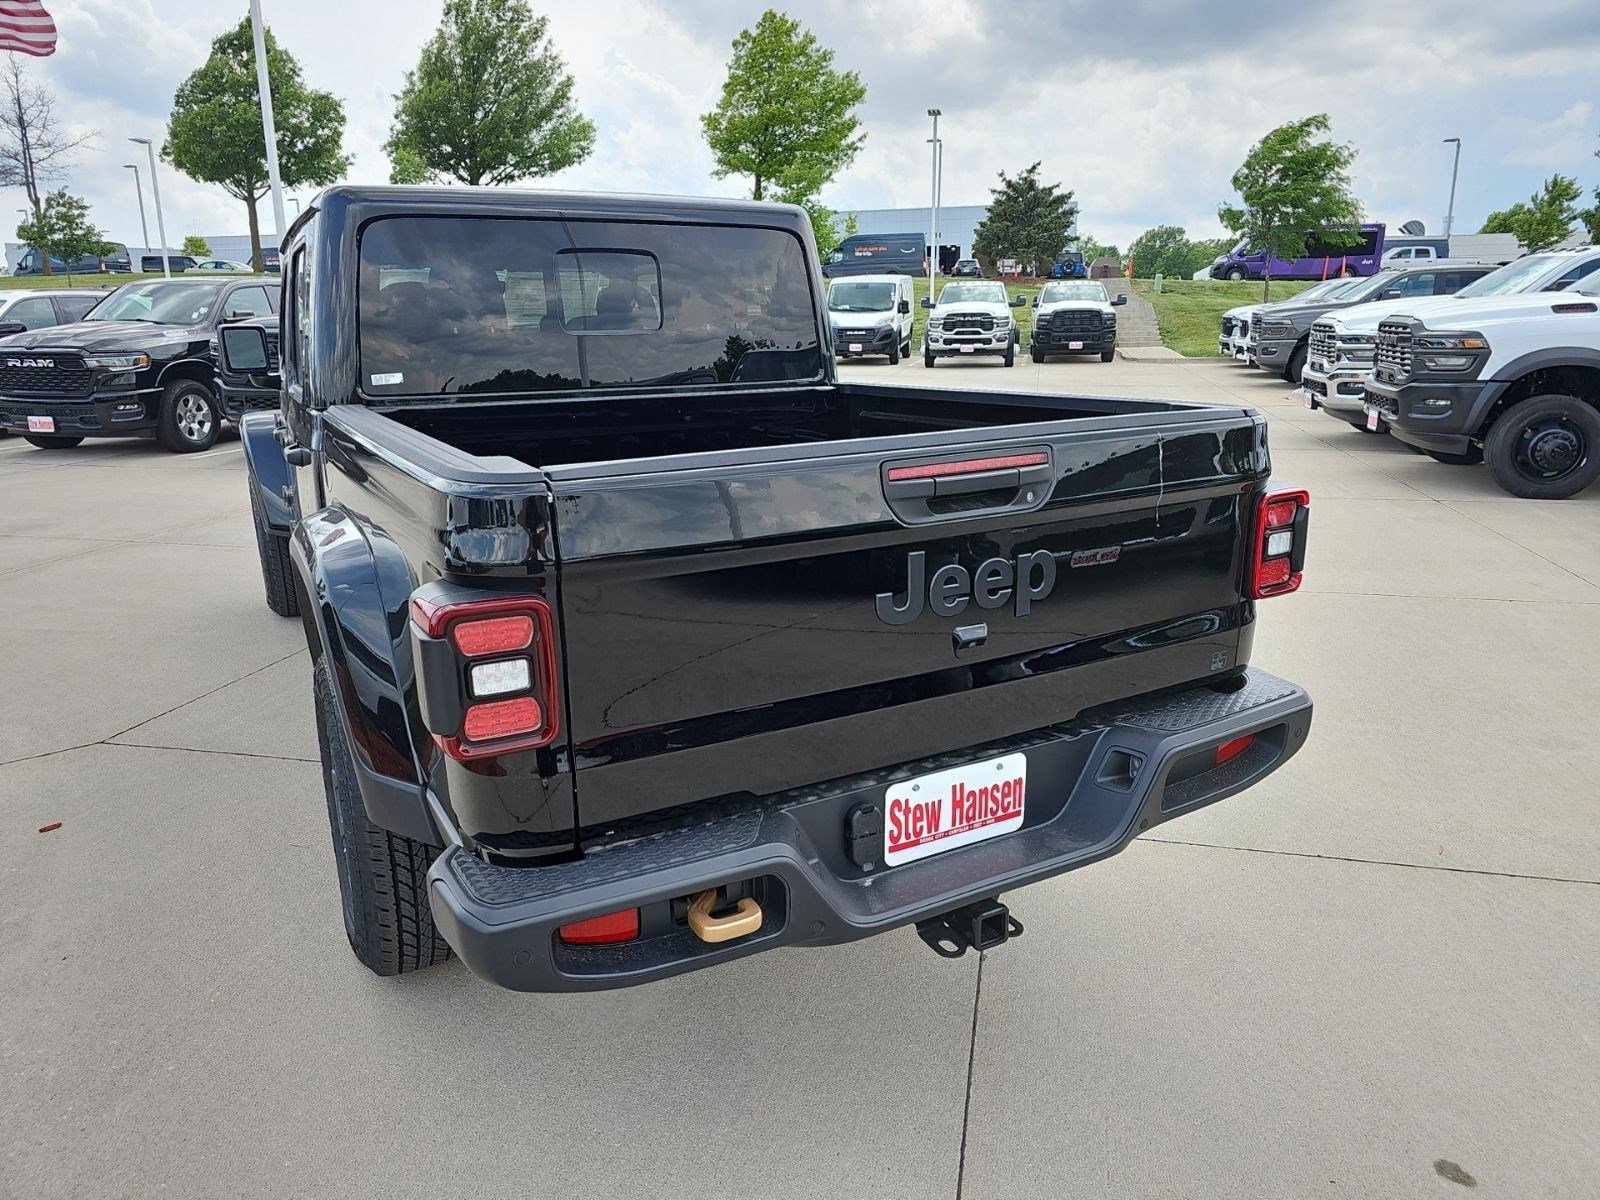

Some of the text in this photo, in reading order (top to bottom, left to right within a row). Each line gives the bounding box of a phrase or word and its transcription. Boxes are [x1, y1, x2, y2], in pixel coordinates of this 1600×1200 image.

[6, 358, 55, 368] RAM
[875, 549, 1057, 625] Jeep
[889, 776, 1023, 844] Stew Hansen
